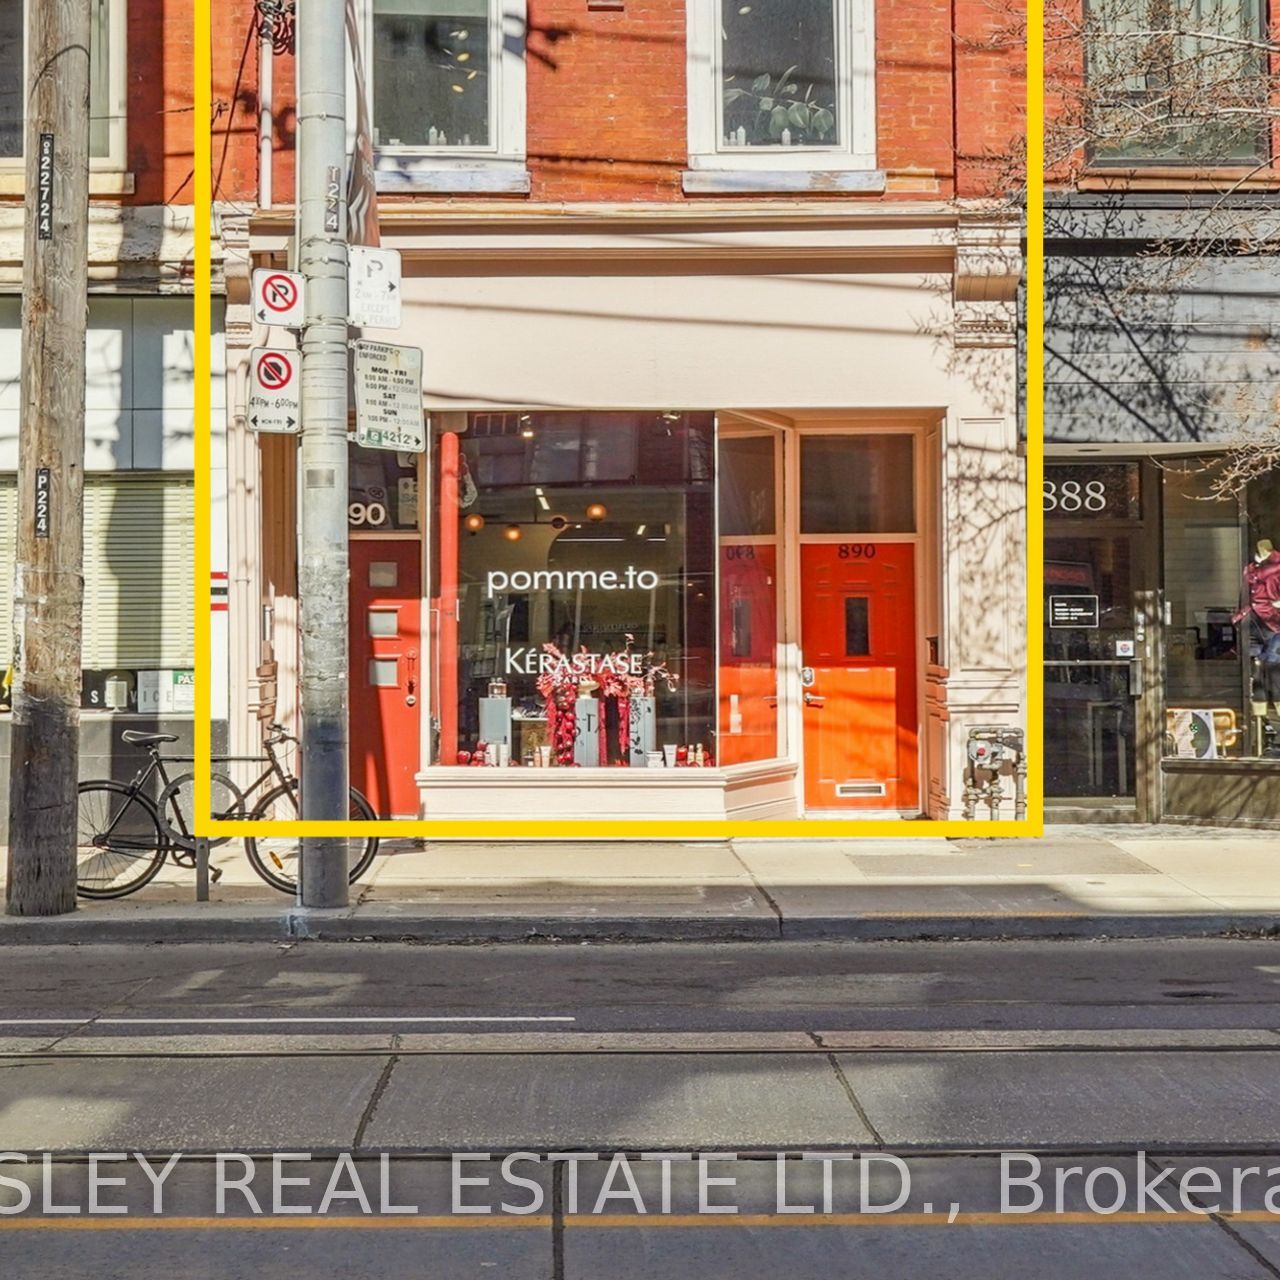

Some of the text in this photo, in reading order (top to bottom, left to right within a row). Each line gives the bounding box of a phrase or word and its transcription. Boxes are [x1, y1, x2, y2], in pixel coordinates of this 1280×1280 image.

[371, 366, 389, 375] MON
[382, 392, 396, 400] SAT
[383, 408, 397, 416] SUN
[37, 475, 47, 531] P224
[838, 543, 876, 559] 890
[487, 566, 658, 599] pomme.to
[505, 647, 643, 674] KÉRASTASE
